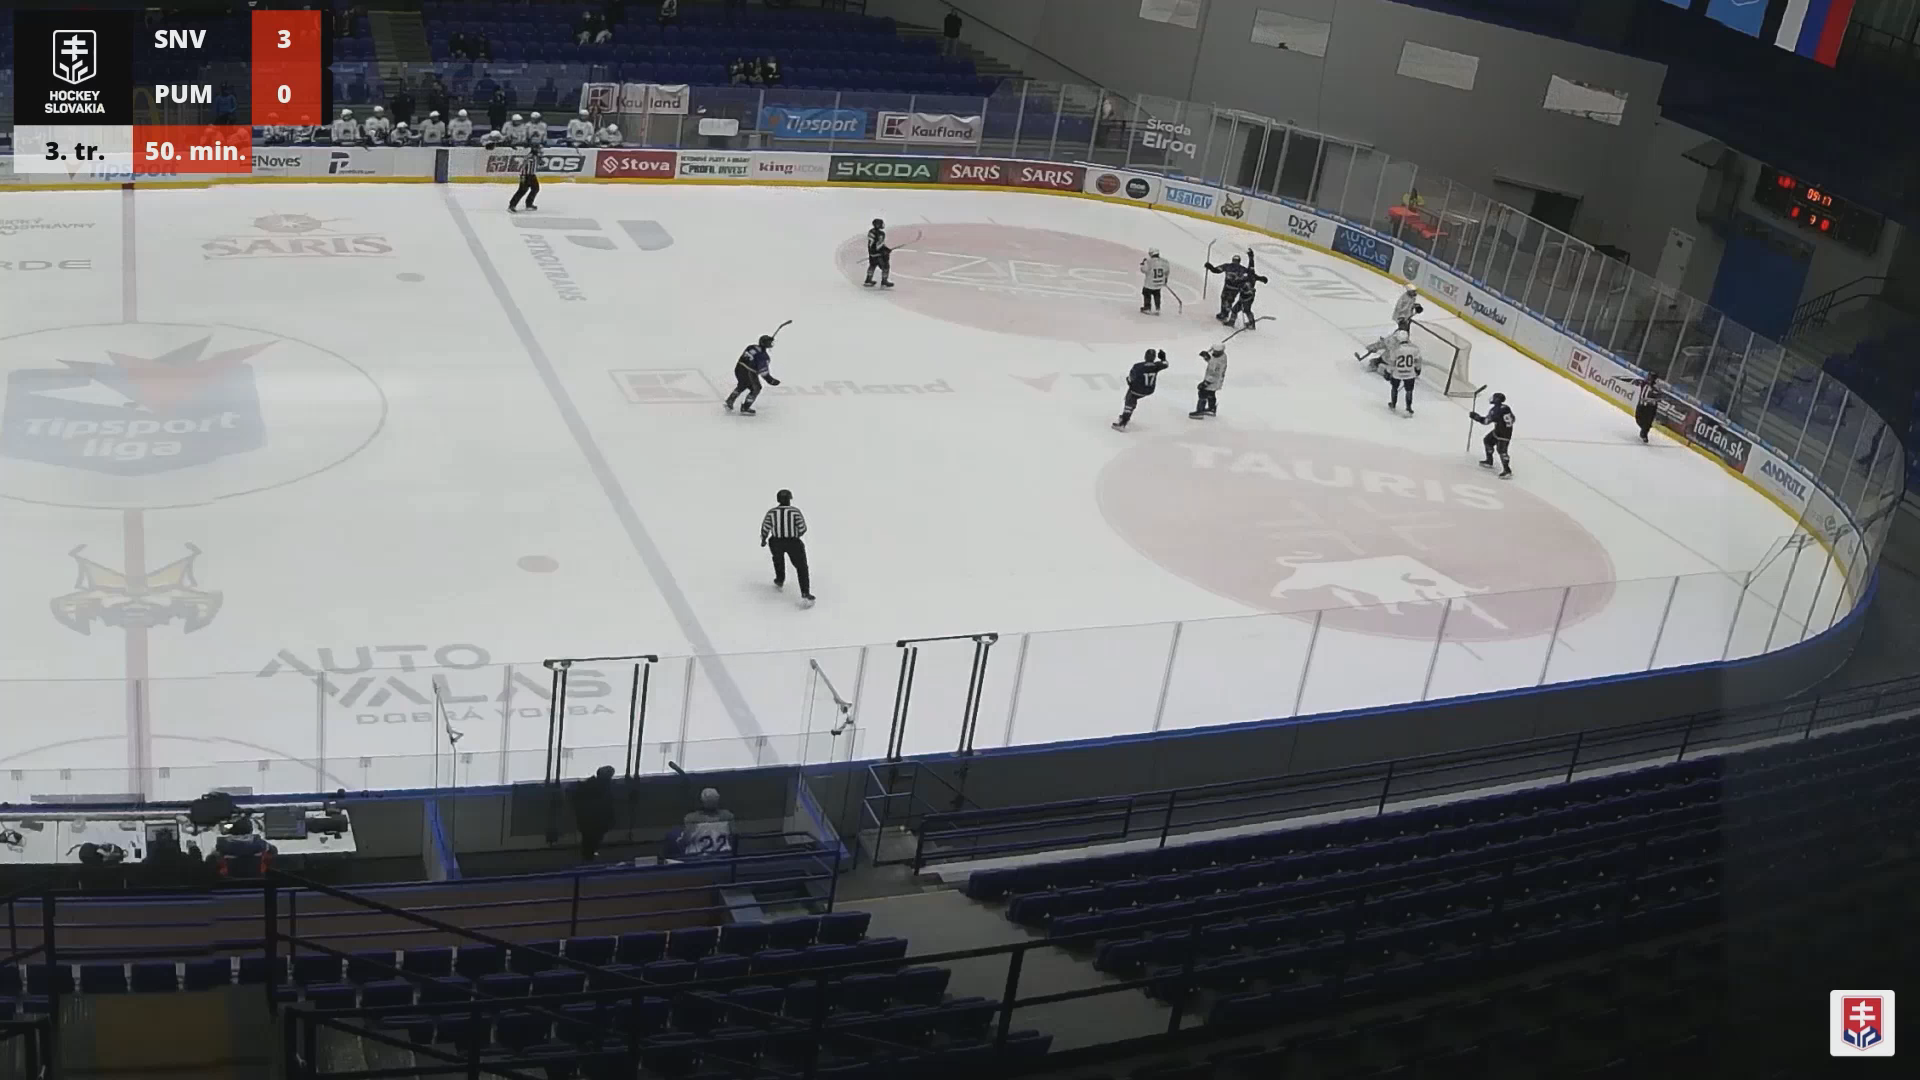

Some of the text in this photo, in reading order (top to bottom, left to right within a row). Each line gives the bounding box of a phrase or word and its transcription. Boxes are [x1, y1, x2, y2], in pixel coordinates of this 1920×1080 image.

[617, 95, 681, 109] Kauland
[785, 114, 858, 132] Tipsport
[911, 125, 973, 139] Kaufland
[1143, 131, 1196, 159] Elroq
[621, 157, 670, 172] Stova
[1397, 354, 1414, 368] 20
[1143, 372, 1157, 387] 17
[1588, 366, 1635, 401] Kaufland
[23, 411, 241, 441] Tipsport
[82, 438, 182, 461] liga
[1693, 415, 1744, 461] forfan.sk
[1174, 442, 1505, 511] TAURIS
[1760, 459, 1806, 501] ANDRITZ
[255, 643, 491, 678] AUTO
[700, 835, 727, 852] 22
